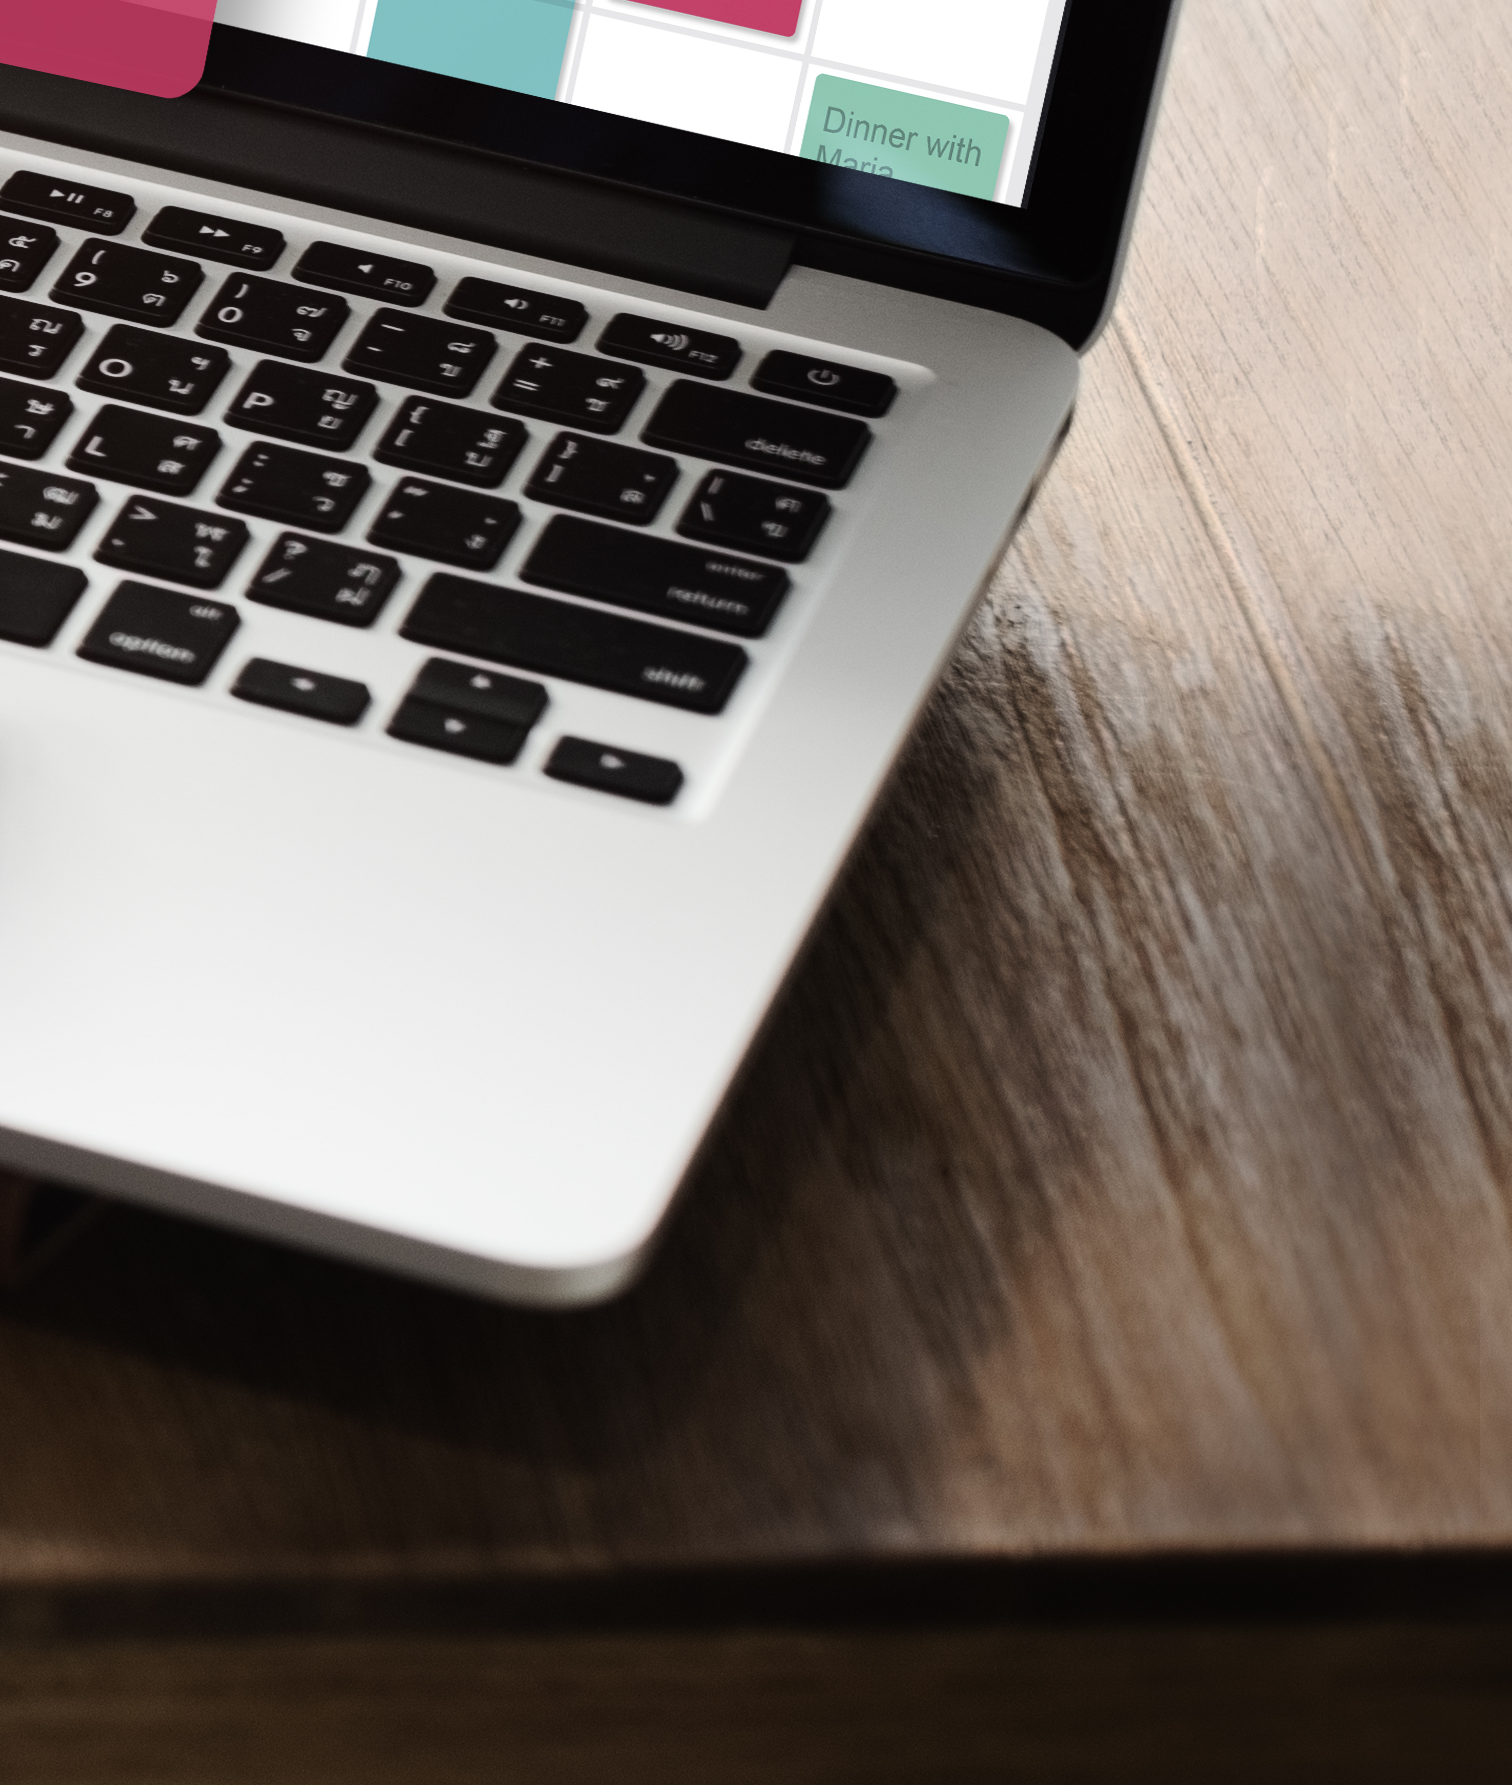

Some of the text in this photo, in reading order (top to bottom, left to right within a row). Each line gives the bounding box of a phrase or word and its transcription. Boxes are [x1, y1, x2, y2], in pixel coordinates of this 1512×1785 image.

[823, 106, 981, 166] Dinner with
[94, 208, 113, 217] F8
[242, 245, 262, 253] F9
[74, 272, 96, 286] 9
[243, 392, 273, 408] P
[85, 436, 105, 456] L
